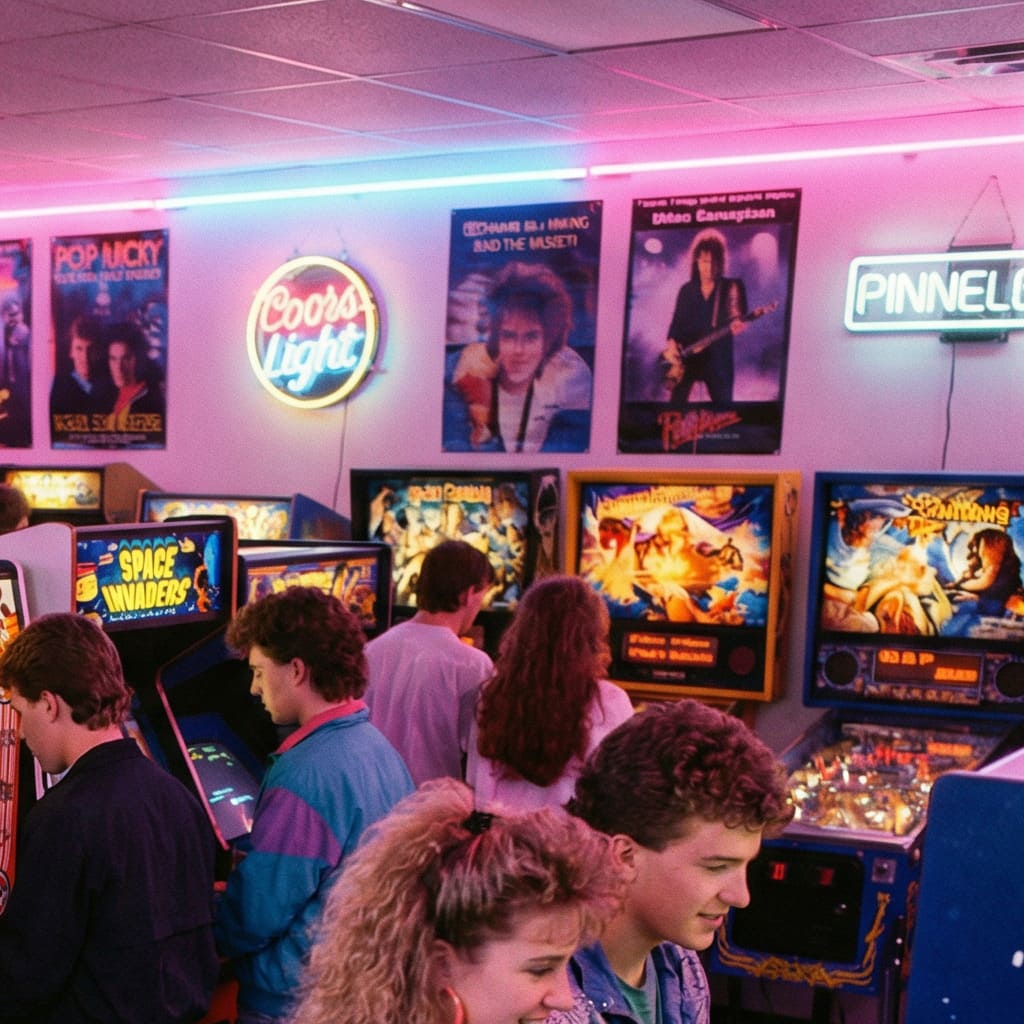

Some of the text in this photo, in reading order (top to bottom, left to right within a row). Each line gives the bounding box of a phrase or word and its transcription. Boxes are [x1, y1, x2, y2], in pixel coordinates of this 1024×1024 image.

[55, 243, 99, 271] POP
[260, 284, 374, 333] Coors
[264, 322, 366, 392] Light
[118, 543, 179, 582] SPACE
[101, 577, 192, 613] INVADERS
